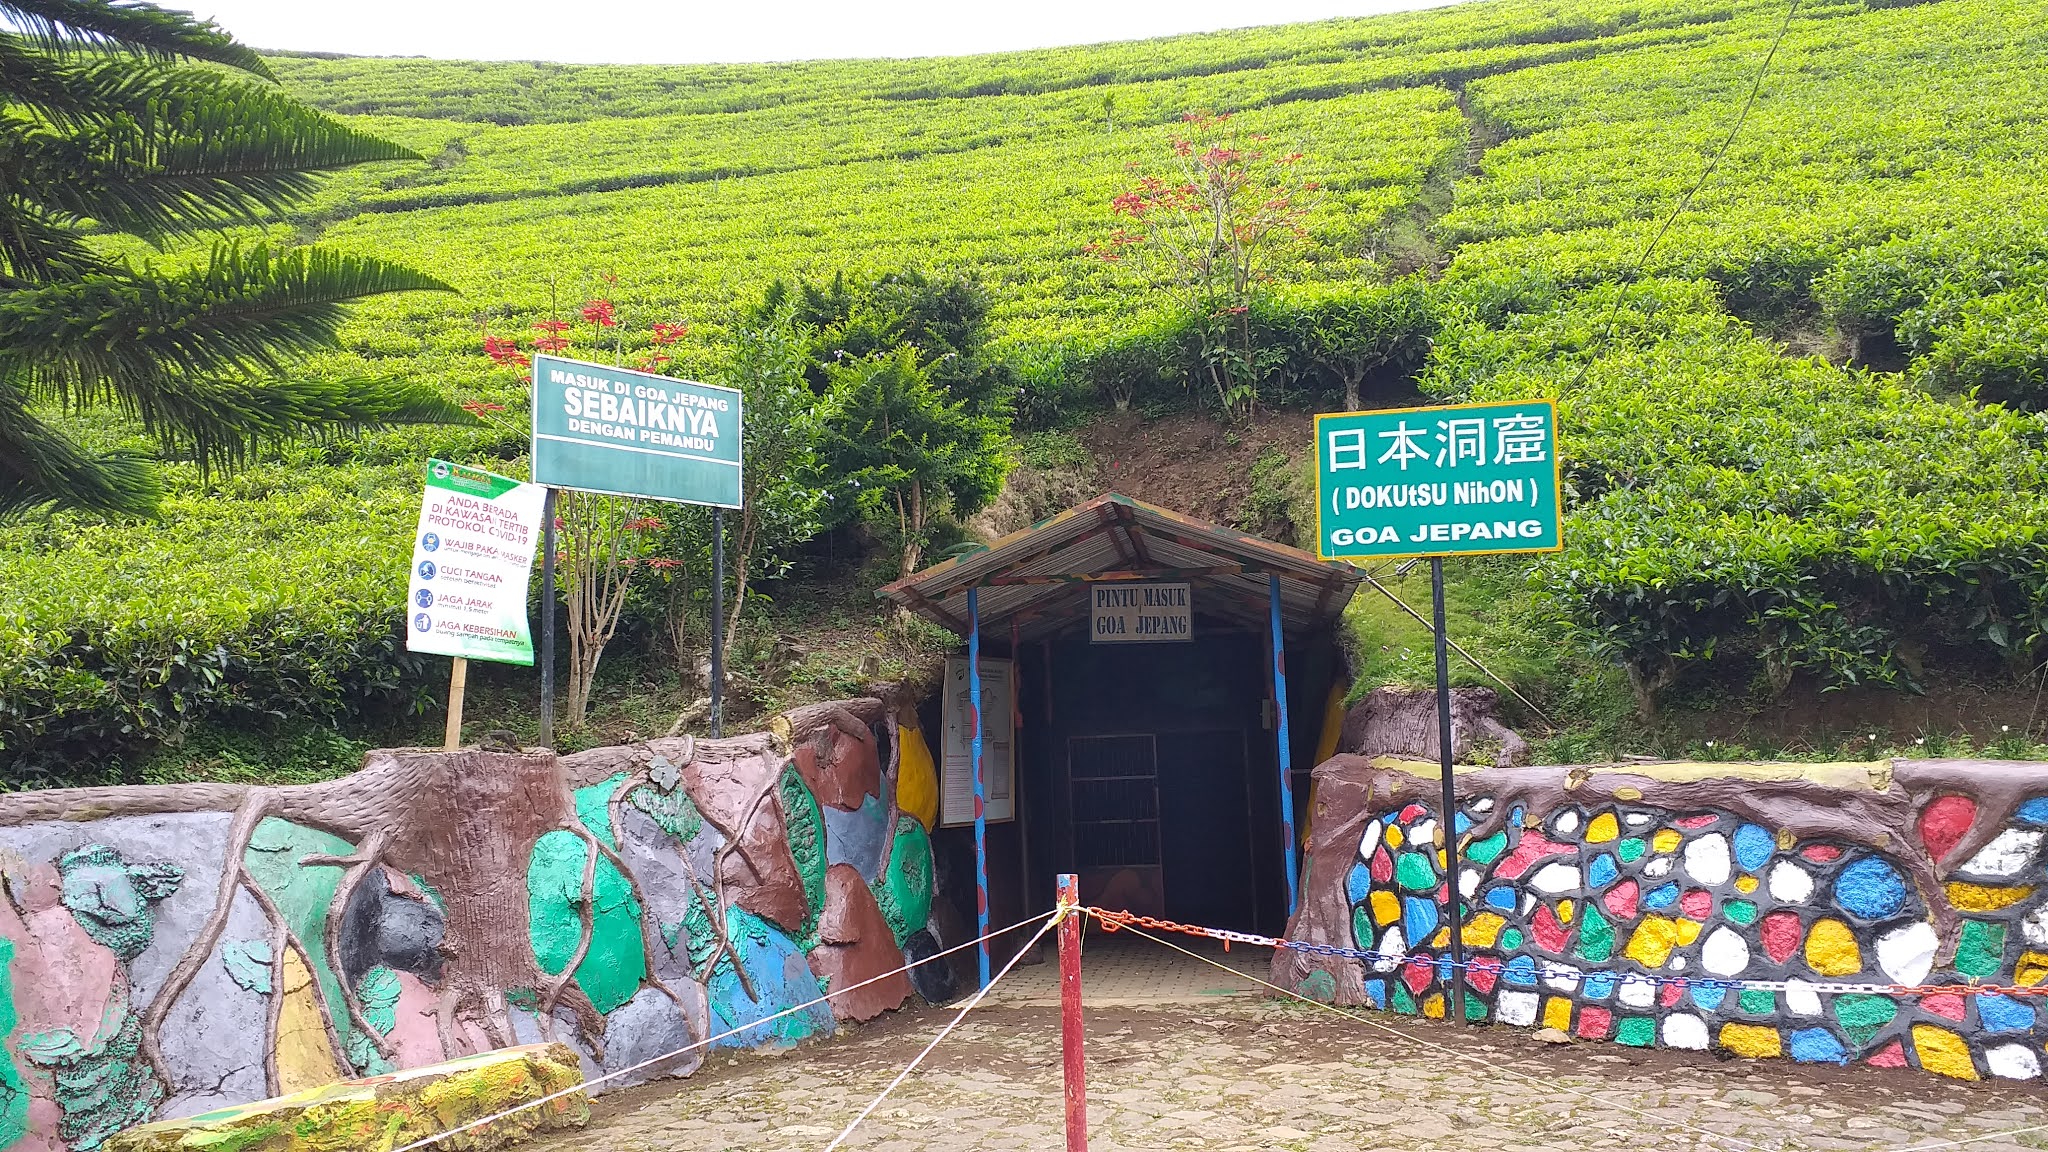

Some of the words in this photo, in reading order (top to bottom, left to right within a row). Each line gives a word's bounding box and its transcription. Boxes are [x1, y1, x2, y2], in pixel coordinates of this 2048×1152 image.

[550, 370, 610, 392] MASUK
[614, 381, 630, 396] DI
[634, 385, 668, 403] GOA
[672, 392, 728, 412] JEPANG
[564, 387, 719, 438] SEBAIKNYA
[568, 418, 636, 440] DENGAN
[640, 430, 714, 452] PEMANDU
[1328, 412, 1546, 472] 日本洞窟
[432, 504, 443, 514] DI
[499, 519, 528, 534] TERTIB
[448, 496, 479, 510] ANDA
[482, 503, 518, 522] BERADA
[428, 514, 486, 534] PROTOKOL
[1332, 525, 1400, 546] GOA
[1410, 520, 1542, 542] JEPANG
[444, 538, 474, 550] WAJIB
[476, 544, 500, 555] PAKA
[440, 566, 462, 576] CUCI
[465, 570, 503, 583] TANGAN
[437, 594, 463, 604] JAGA
[465, 598, 493, 610] JARAK
[1096, 589, 1138, 608] PINTU
[1144, 588, 1186, 606] MASUK
[435, 620, 460, 631] JAGA
[463, 624, 517, 638] KEBERSIHAN
[1096, 616, 1126, 634] GOA
[1136, 615, 1187, 634] JEPANG
